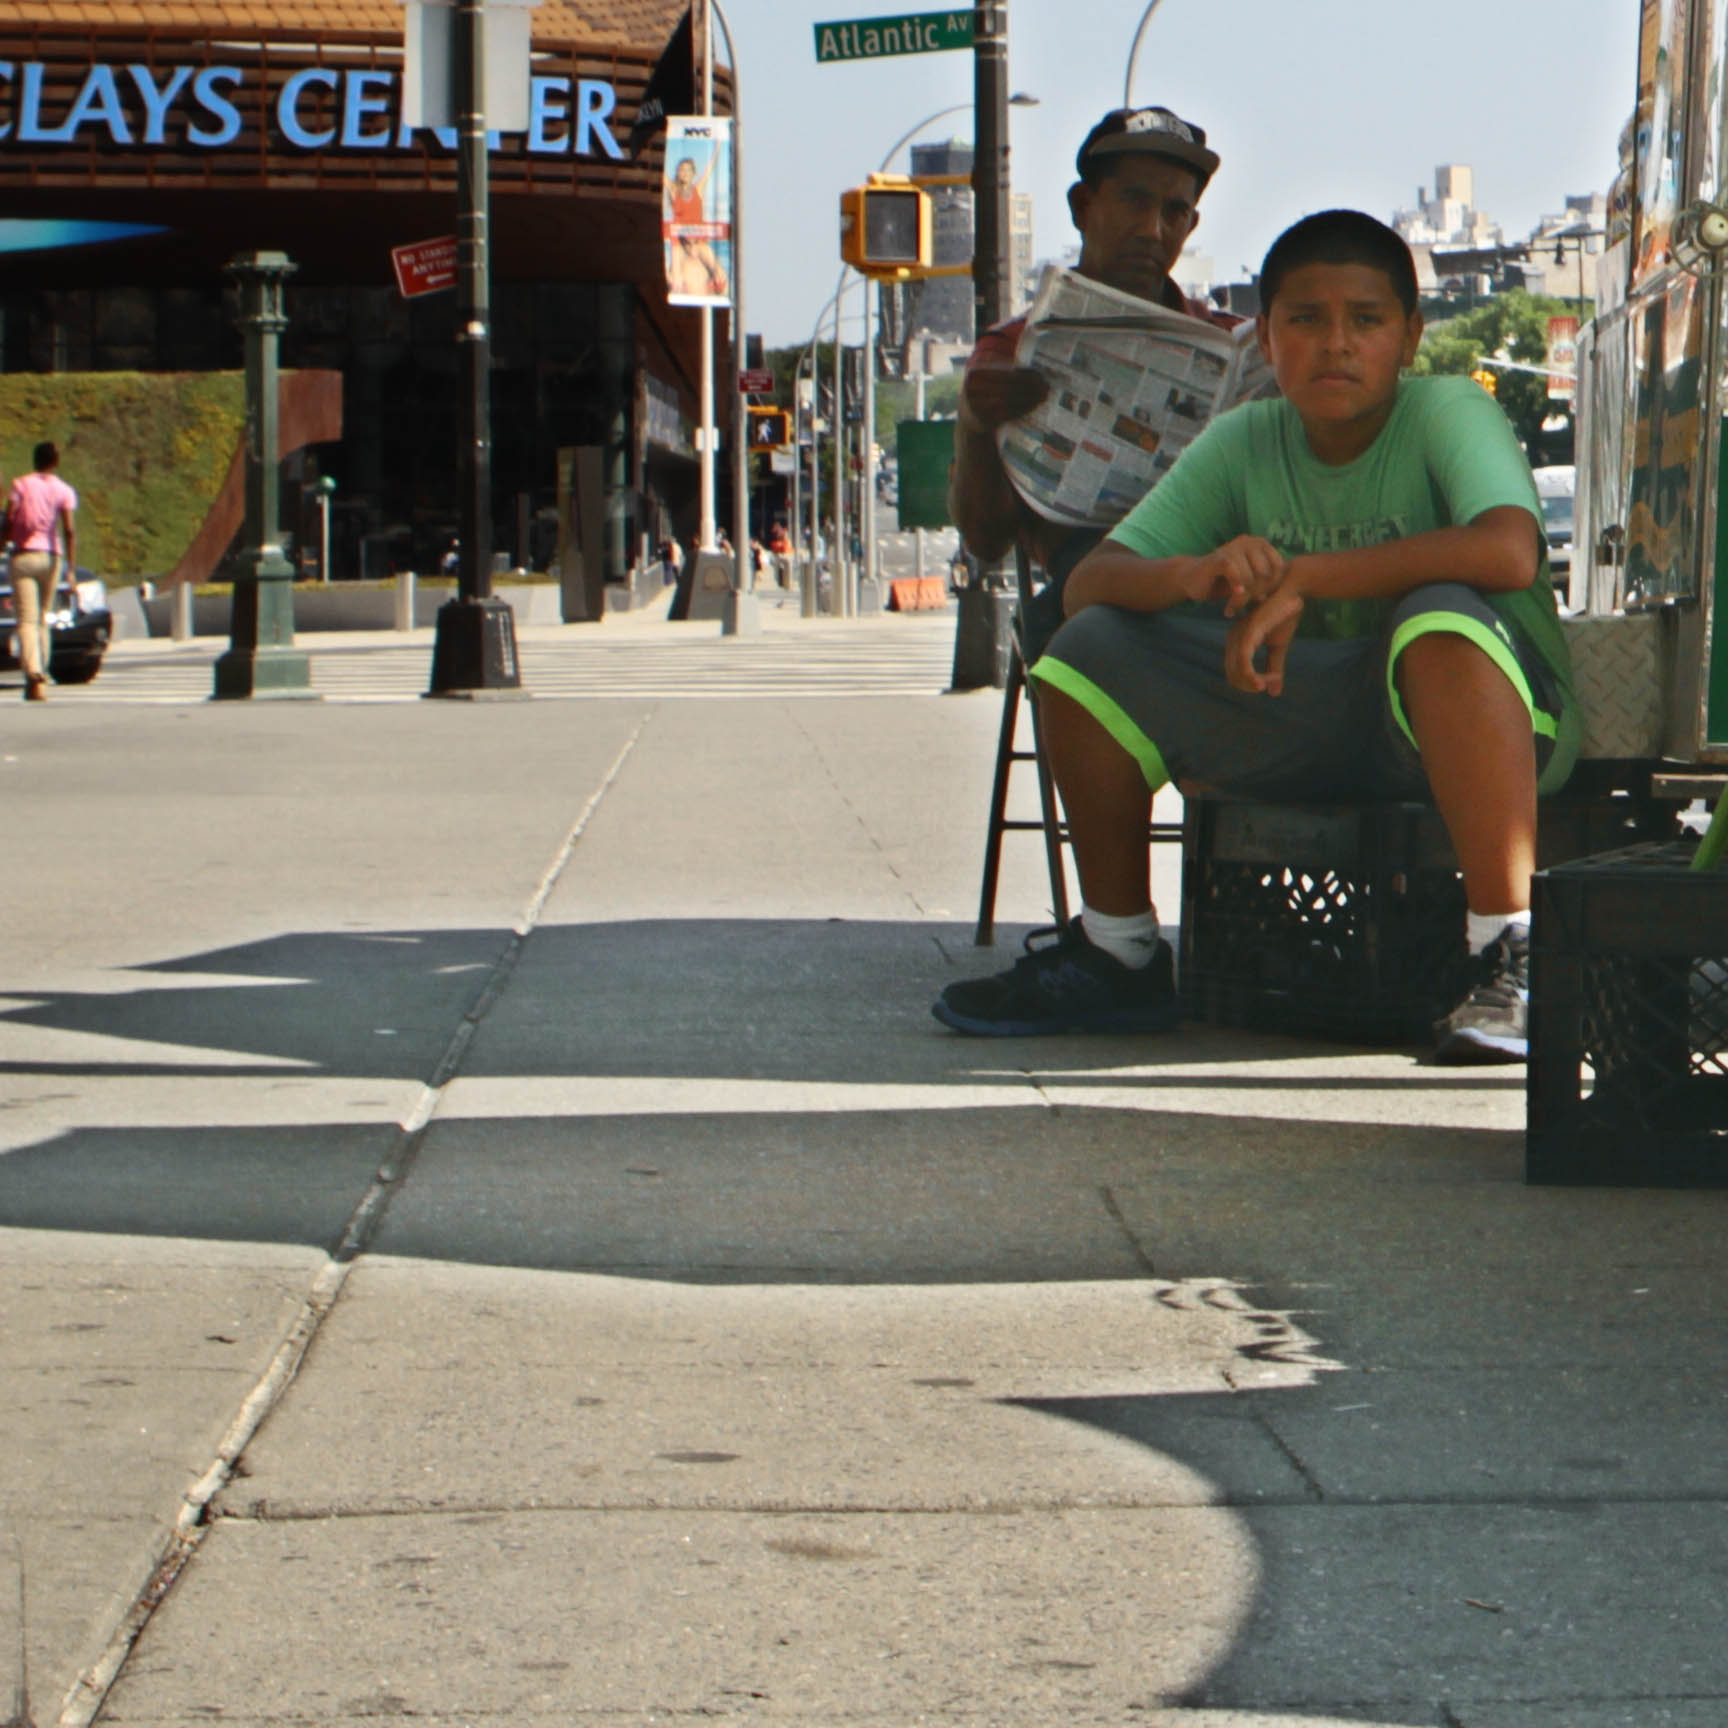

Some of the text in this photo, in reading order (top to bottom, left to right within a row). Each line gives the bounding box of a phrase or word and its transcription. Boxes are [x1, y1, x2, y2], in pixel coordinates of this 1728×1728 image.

[820, 13, 969, 58] Atlantic Av
[0, 61, 625, 161] LAYS CEER
[684, 126, 712, 138] NYC
